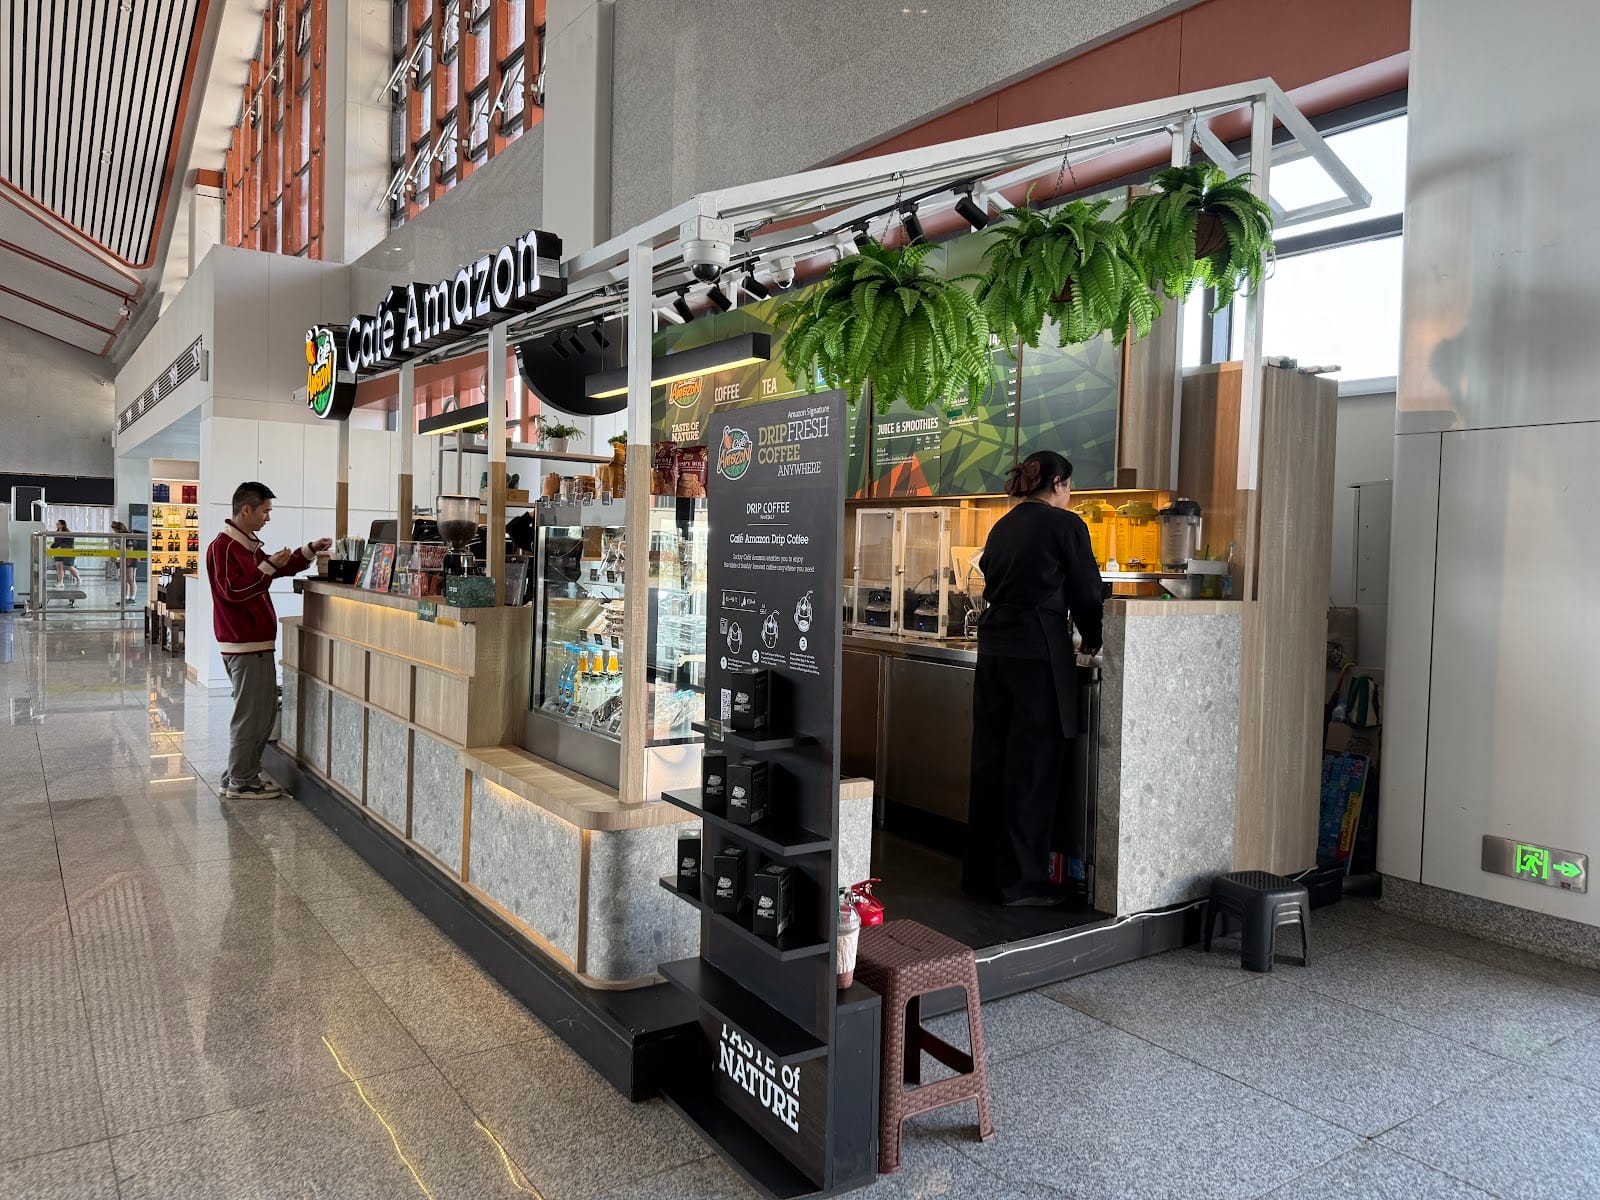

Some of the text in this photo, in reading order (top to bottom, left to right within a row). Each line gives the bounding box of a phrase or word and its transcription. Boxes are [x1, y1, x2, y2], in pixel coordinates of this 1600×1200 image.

[346, 229, 541, 374] Café Amazon
[714, 378, 777, 402] COFFEE TEA
[787, 405, 830, 418] Amazon Signature
[671, 423, 690, 433] TASTE
[758, 427, 787, 446] DRIP
[787, 416, 830, 442] FRESH
[877, 421, 894, 435] JUICE
[895, 422, 901, 430] &
[901, 417, 939, 433] SMOOTHIES
[671, 431, 700, 442] NATURE
[757, 443, 801, 465] COFFEE
[777, 461, 821, 477] ANYWHERE
[746, 501, 790, 514] DRIP COFFEE
[729, 533, 809, 546] Café Amazon Drip Coffee
[718, 1040, 800, 1134] NATURE
